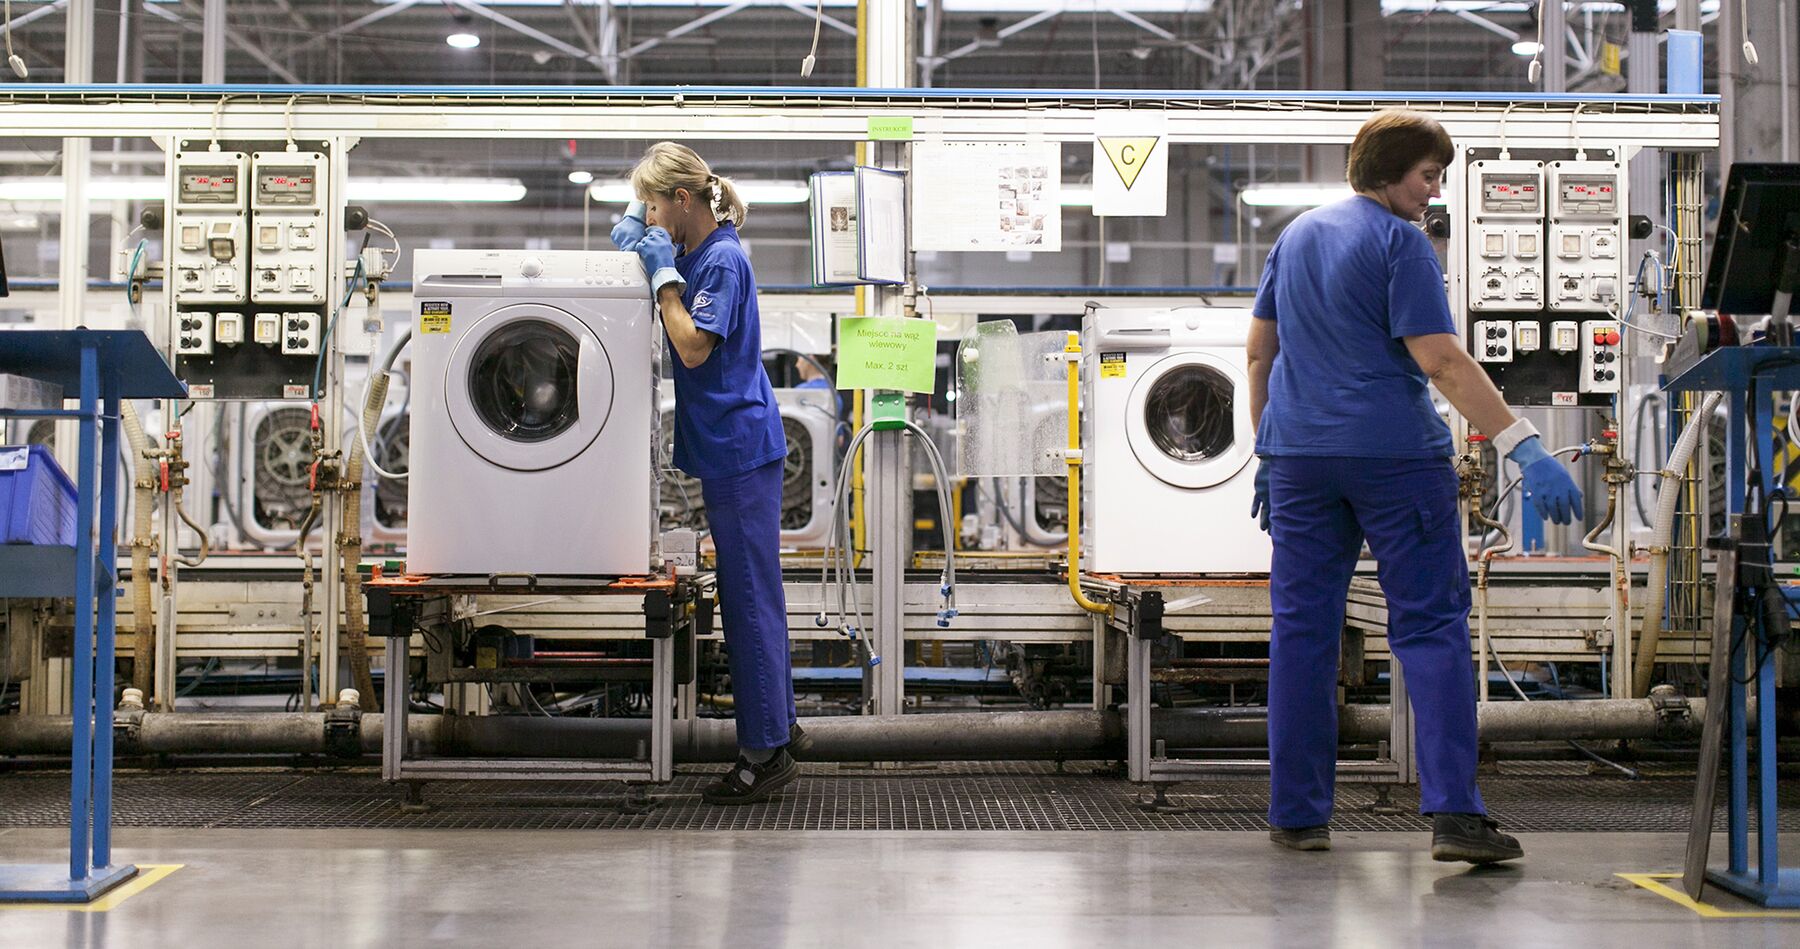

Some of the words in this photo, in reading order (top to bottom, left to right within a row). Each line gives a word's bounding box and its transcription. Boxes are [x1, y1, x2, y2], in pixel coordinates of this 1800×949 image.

[1121, 144, 1135, 166] C
[857, 329, 889, 339] Miejsce
[868, 341, 907, 351] wlewowy
[888, 361, 894, 371] 2
